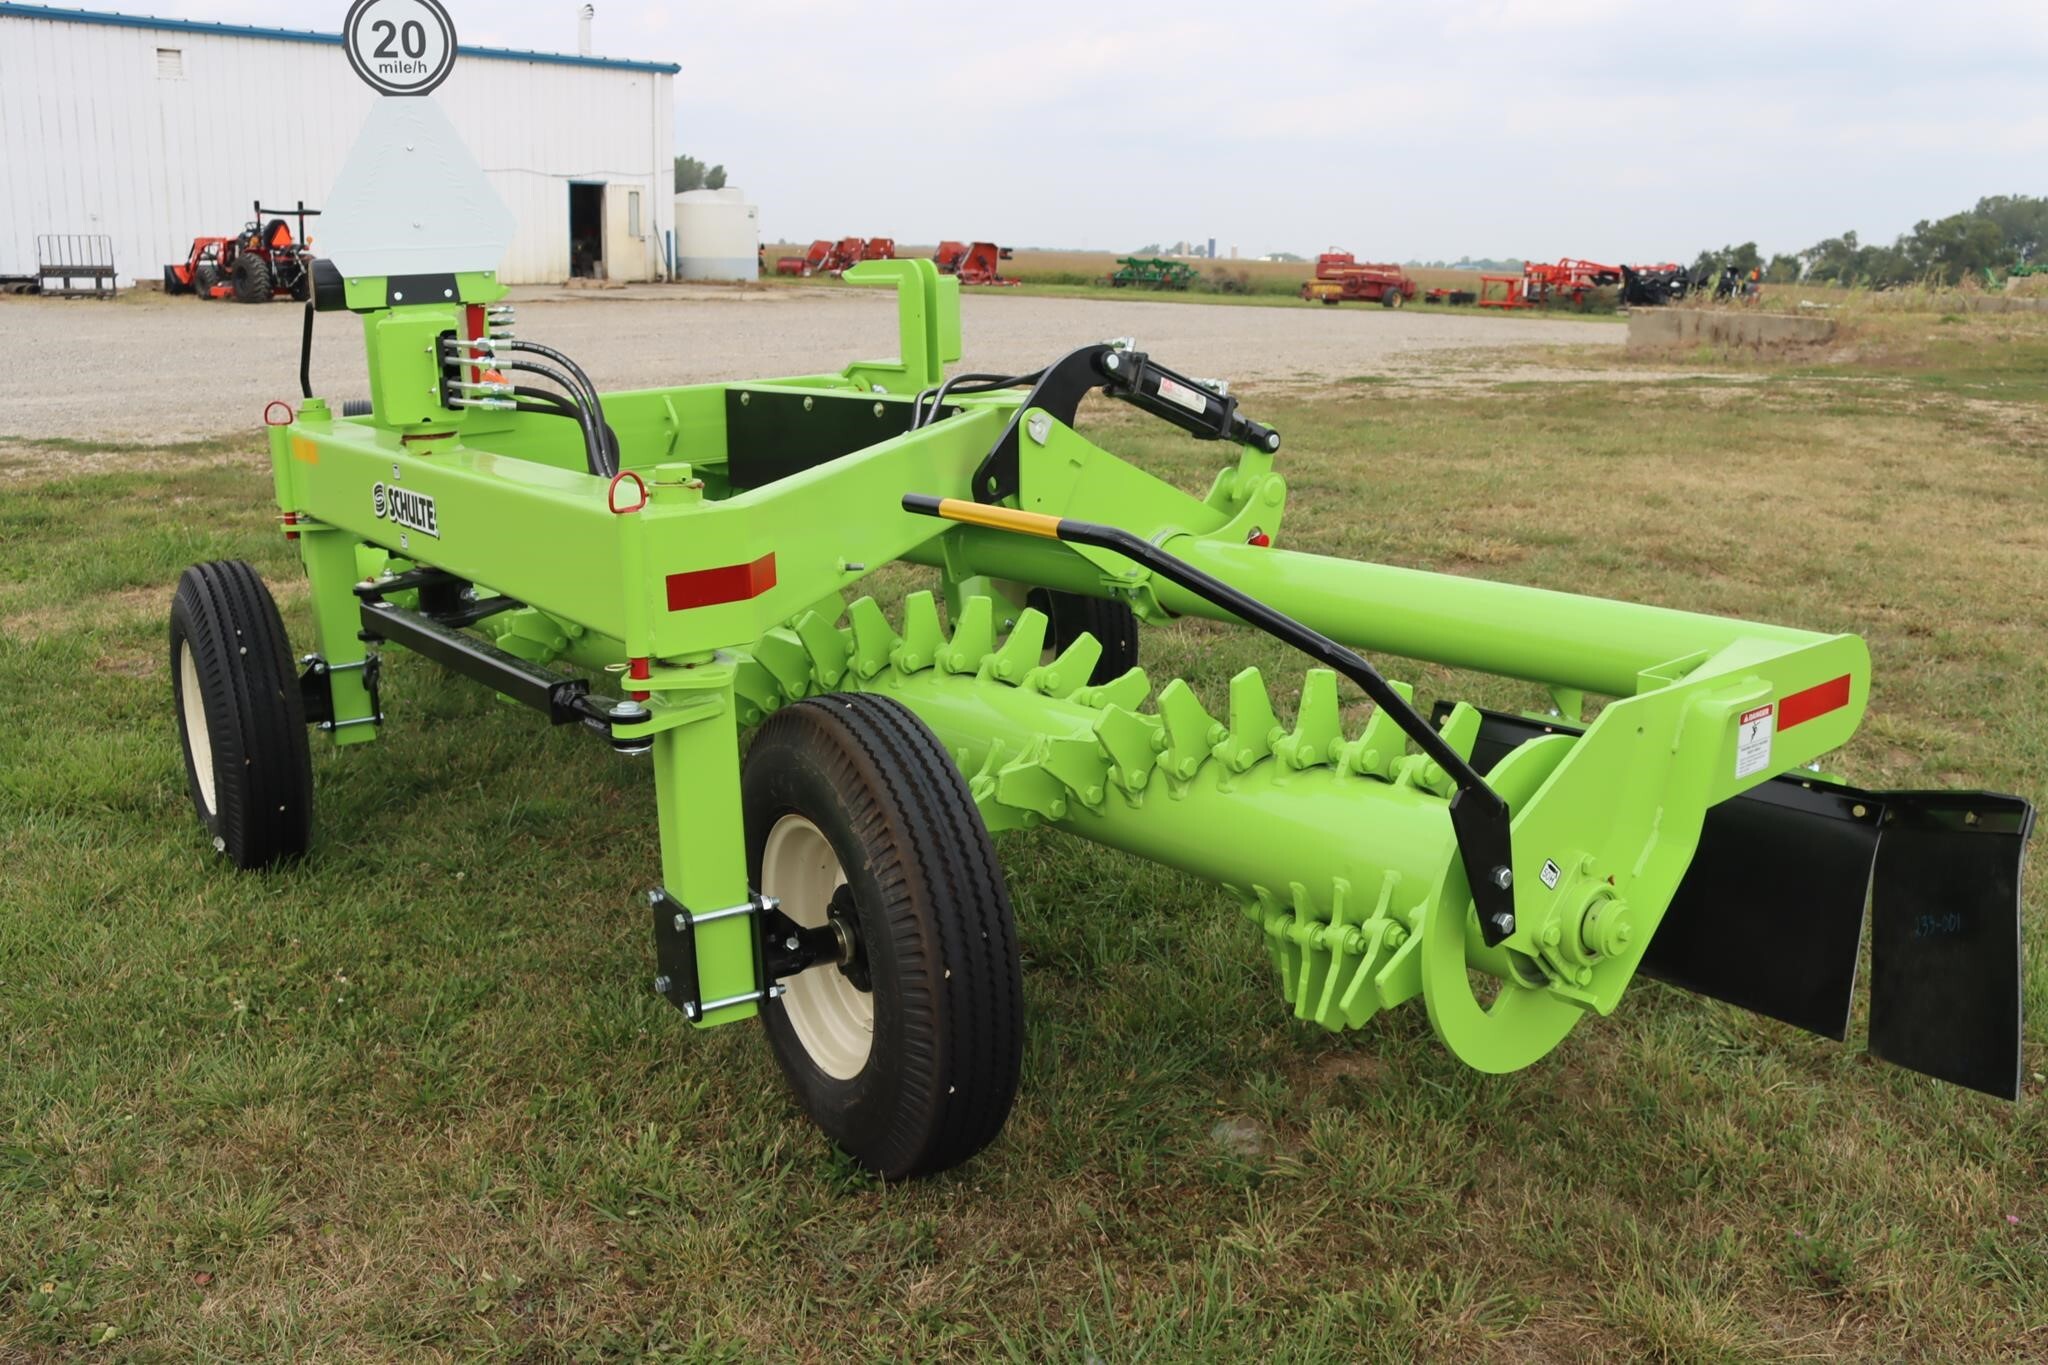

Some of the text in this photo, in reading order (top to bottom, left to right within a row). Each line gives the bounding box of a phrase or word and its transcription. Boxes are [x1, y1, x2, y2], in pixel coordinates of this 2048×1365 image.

[372, 20, 426, 59] 20
[379, 61, 427, 73] mile/h
[388, 487, 436, 532] SCHULTE
